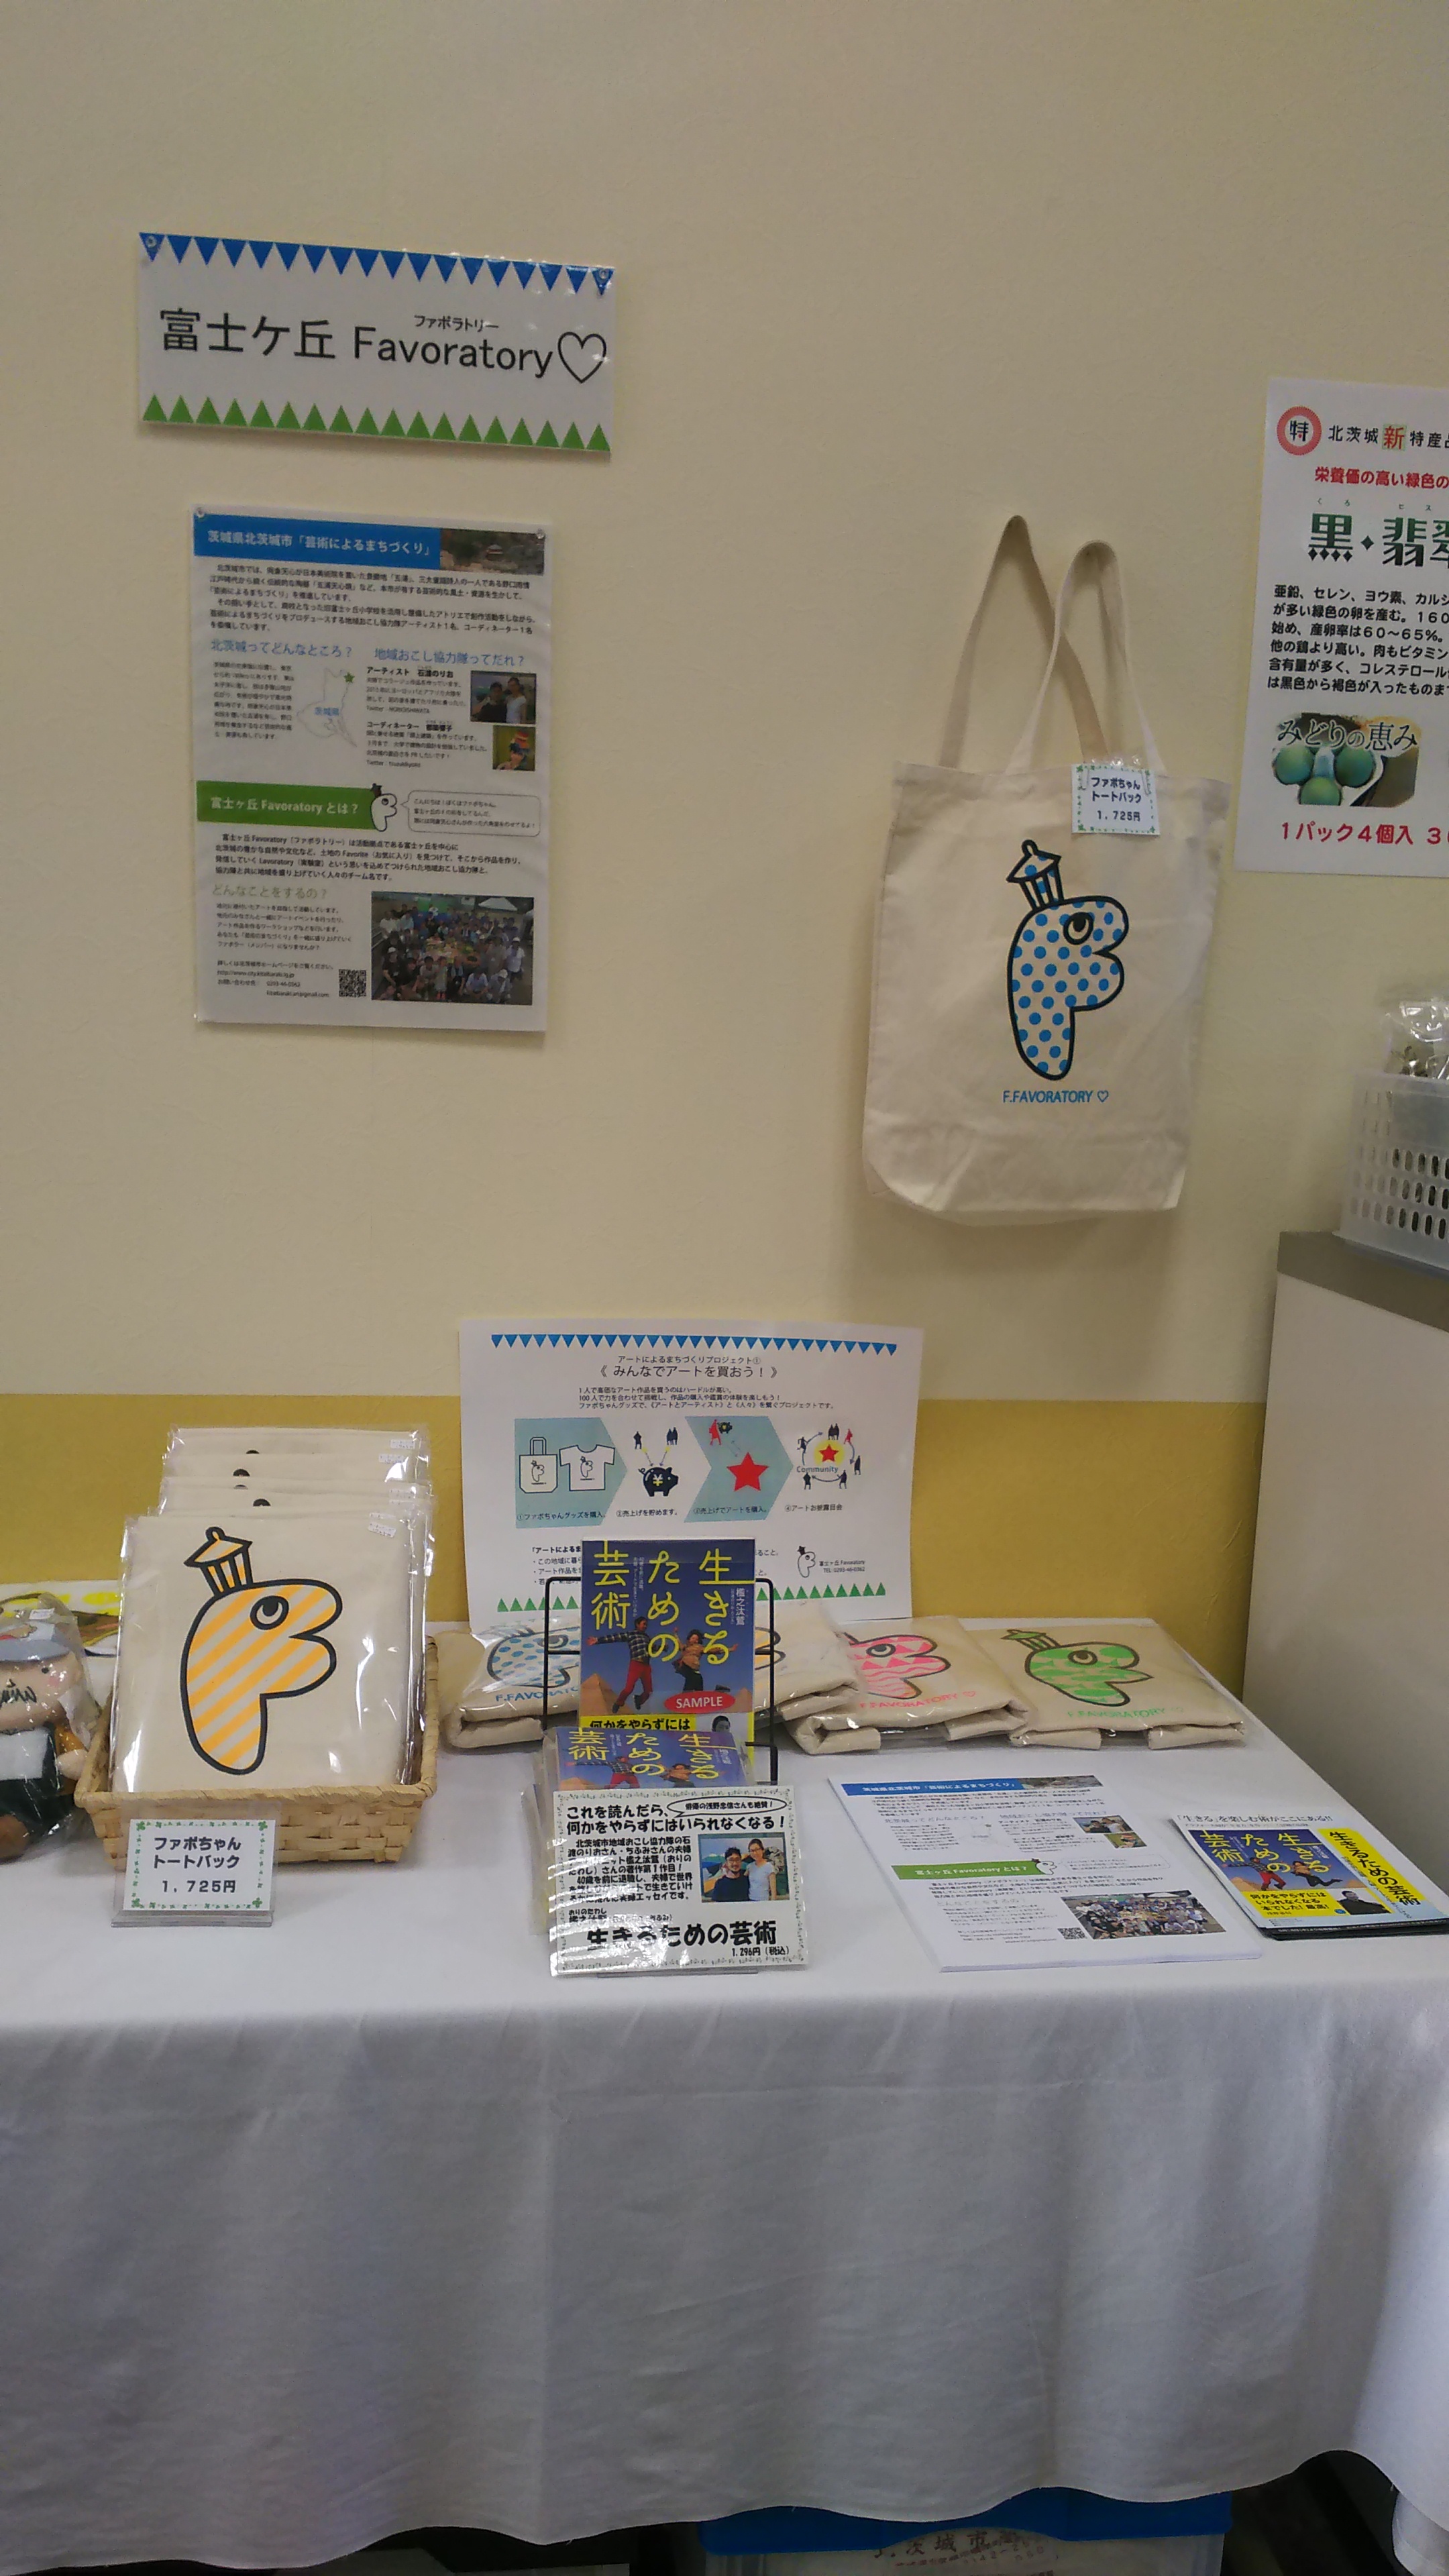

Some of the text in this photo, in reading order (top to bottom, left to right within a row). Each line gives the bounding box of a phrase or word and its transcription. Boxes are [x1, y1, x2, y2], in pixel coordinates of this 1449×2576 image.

[353, 326, 553, 378] Favoratory
[1289, 420, 1309, 441] 特
[1314, 466, 1449, 490] 栄養価の高い緑色の
[1269, 657, 1449, 679] 含有量が多く、コレステロール
[1267, 676, 1449, 696] は黒色から褐色が入ったものま
[1277, 718, 1418, 751] みどりの恵み
[261, 800, 322, 816] Favoratory
[1003, 1089, 1093, 1104] F.FAVORATORY
[591, 1540, 631, 1630] 芸術
[647, 1550, 680, 1662] ための
[676, 1695, 724, 1709] SAMPLE
[567, 1805, 669, 1819] これを読んだら、
[567, 1815, 785, 1835] 何かをやらずにはいられなくなる！
[154, 1836, 241, 1851] ファボちゃん
[154, 1855, 239, 1869] トートバック
[953, 1866, 1000, 1874] Favoratory
